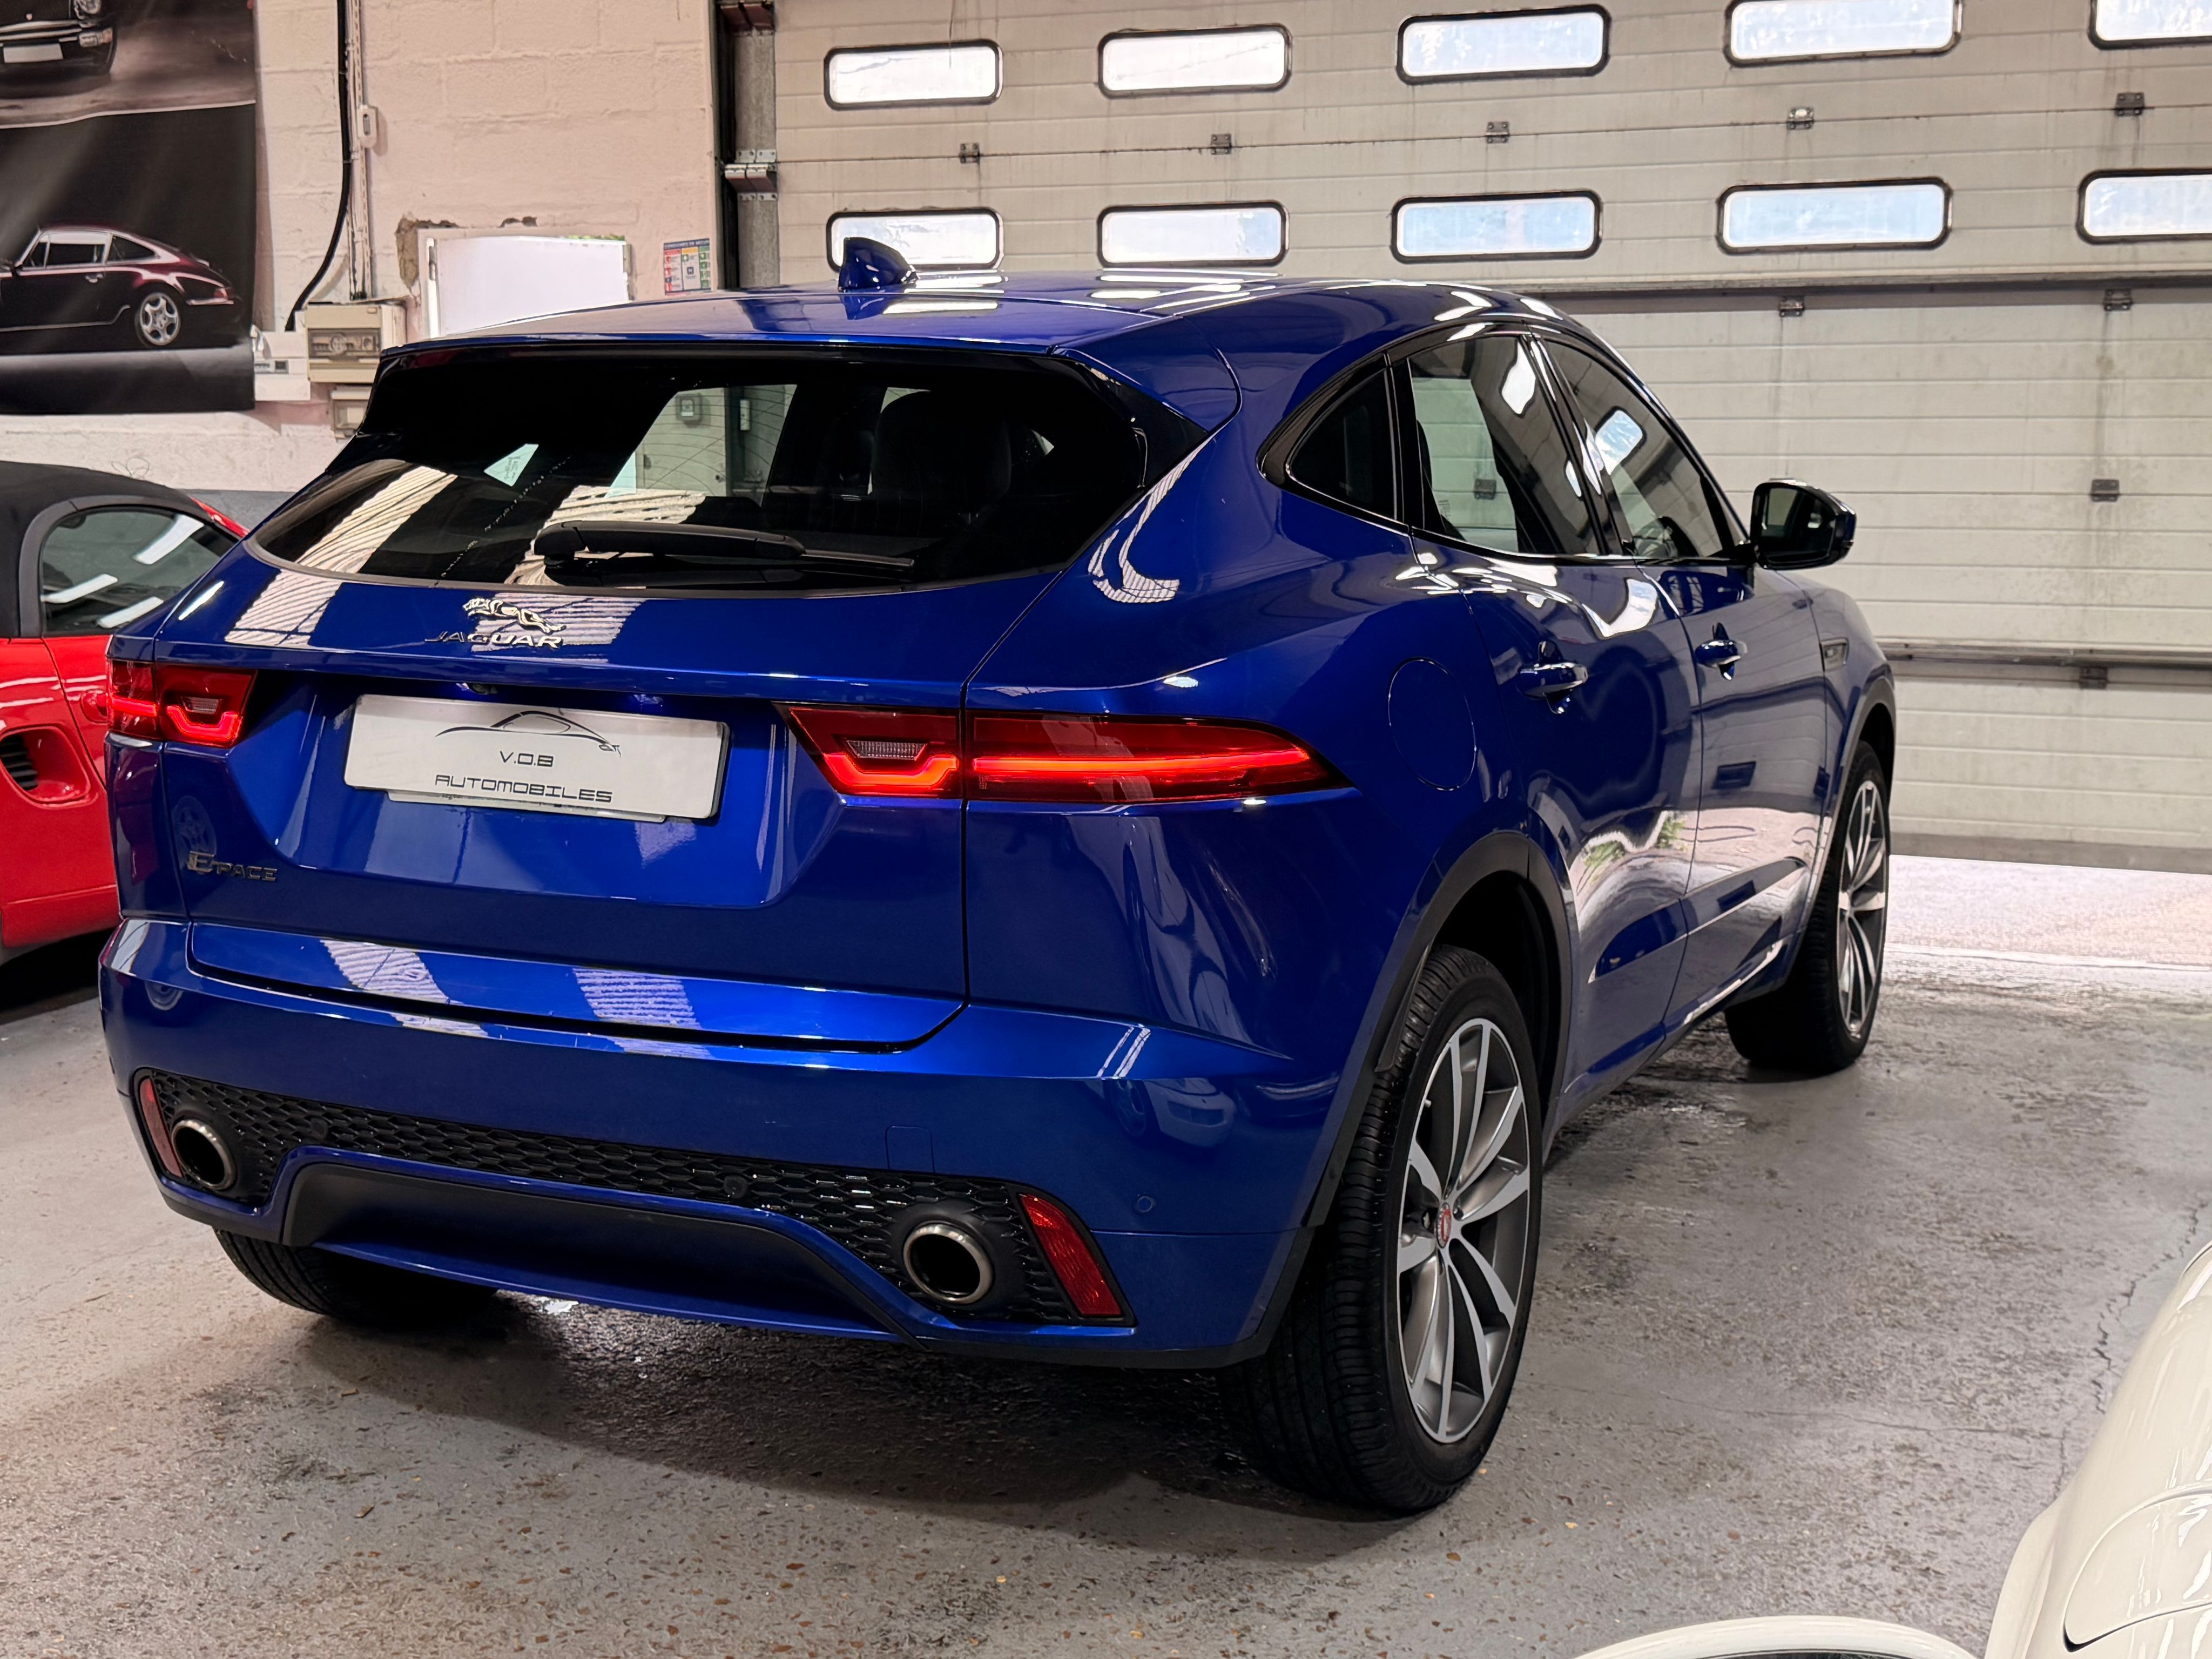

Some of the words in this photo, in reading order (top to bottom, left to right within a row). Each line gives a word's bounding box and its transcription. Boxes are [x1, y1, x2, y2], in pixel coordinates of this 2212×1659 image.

[424, 631, 563, 648] JAGUAR
[500, 750, 554, 767] V.O.B
[435, 774, 613, 802] AUTOMOBILES
